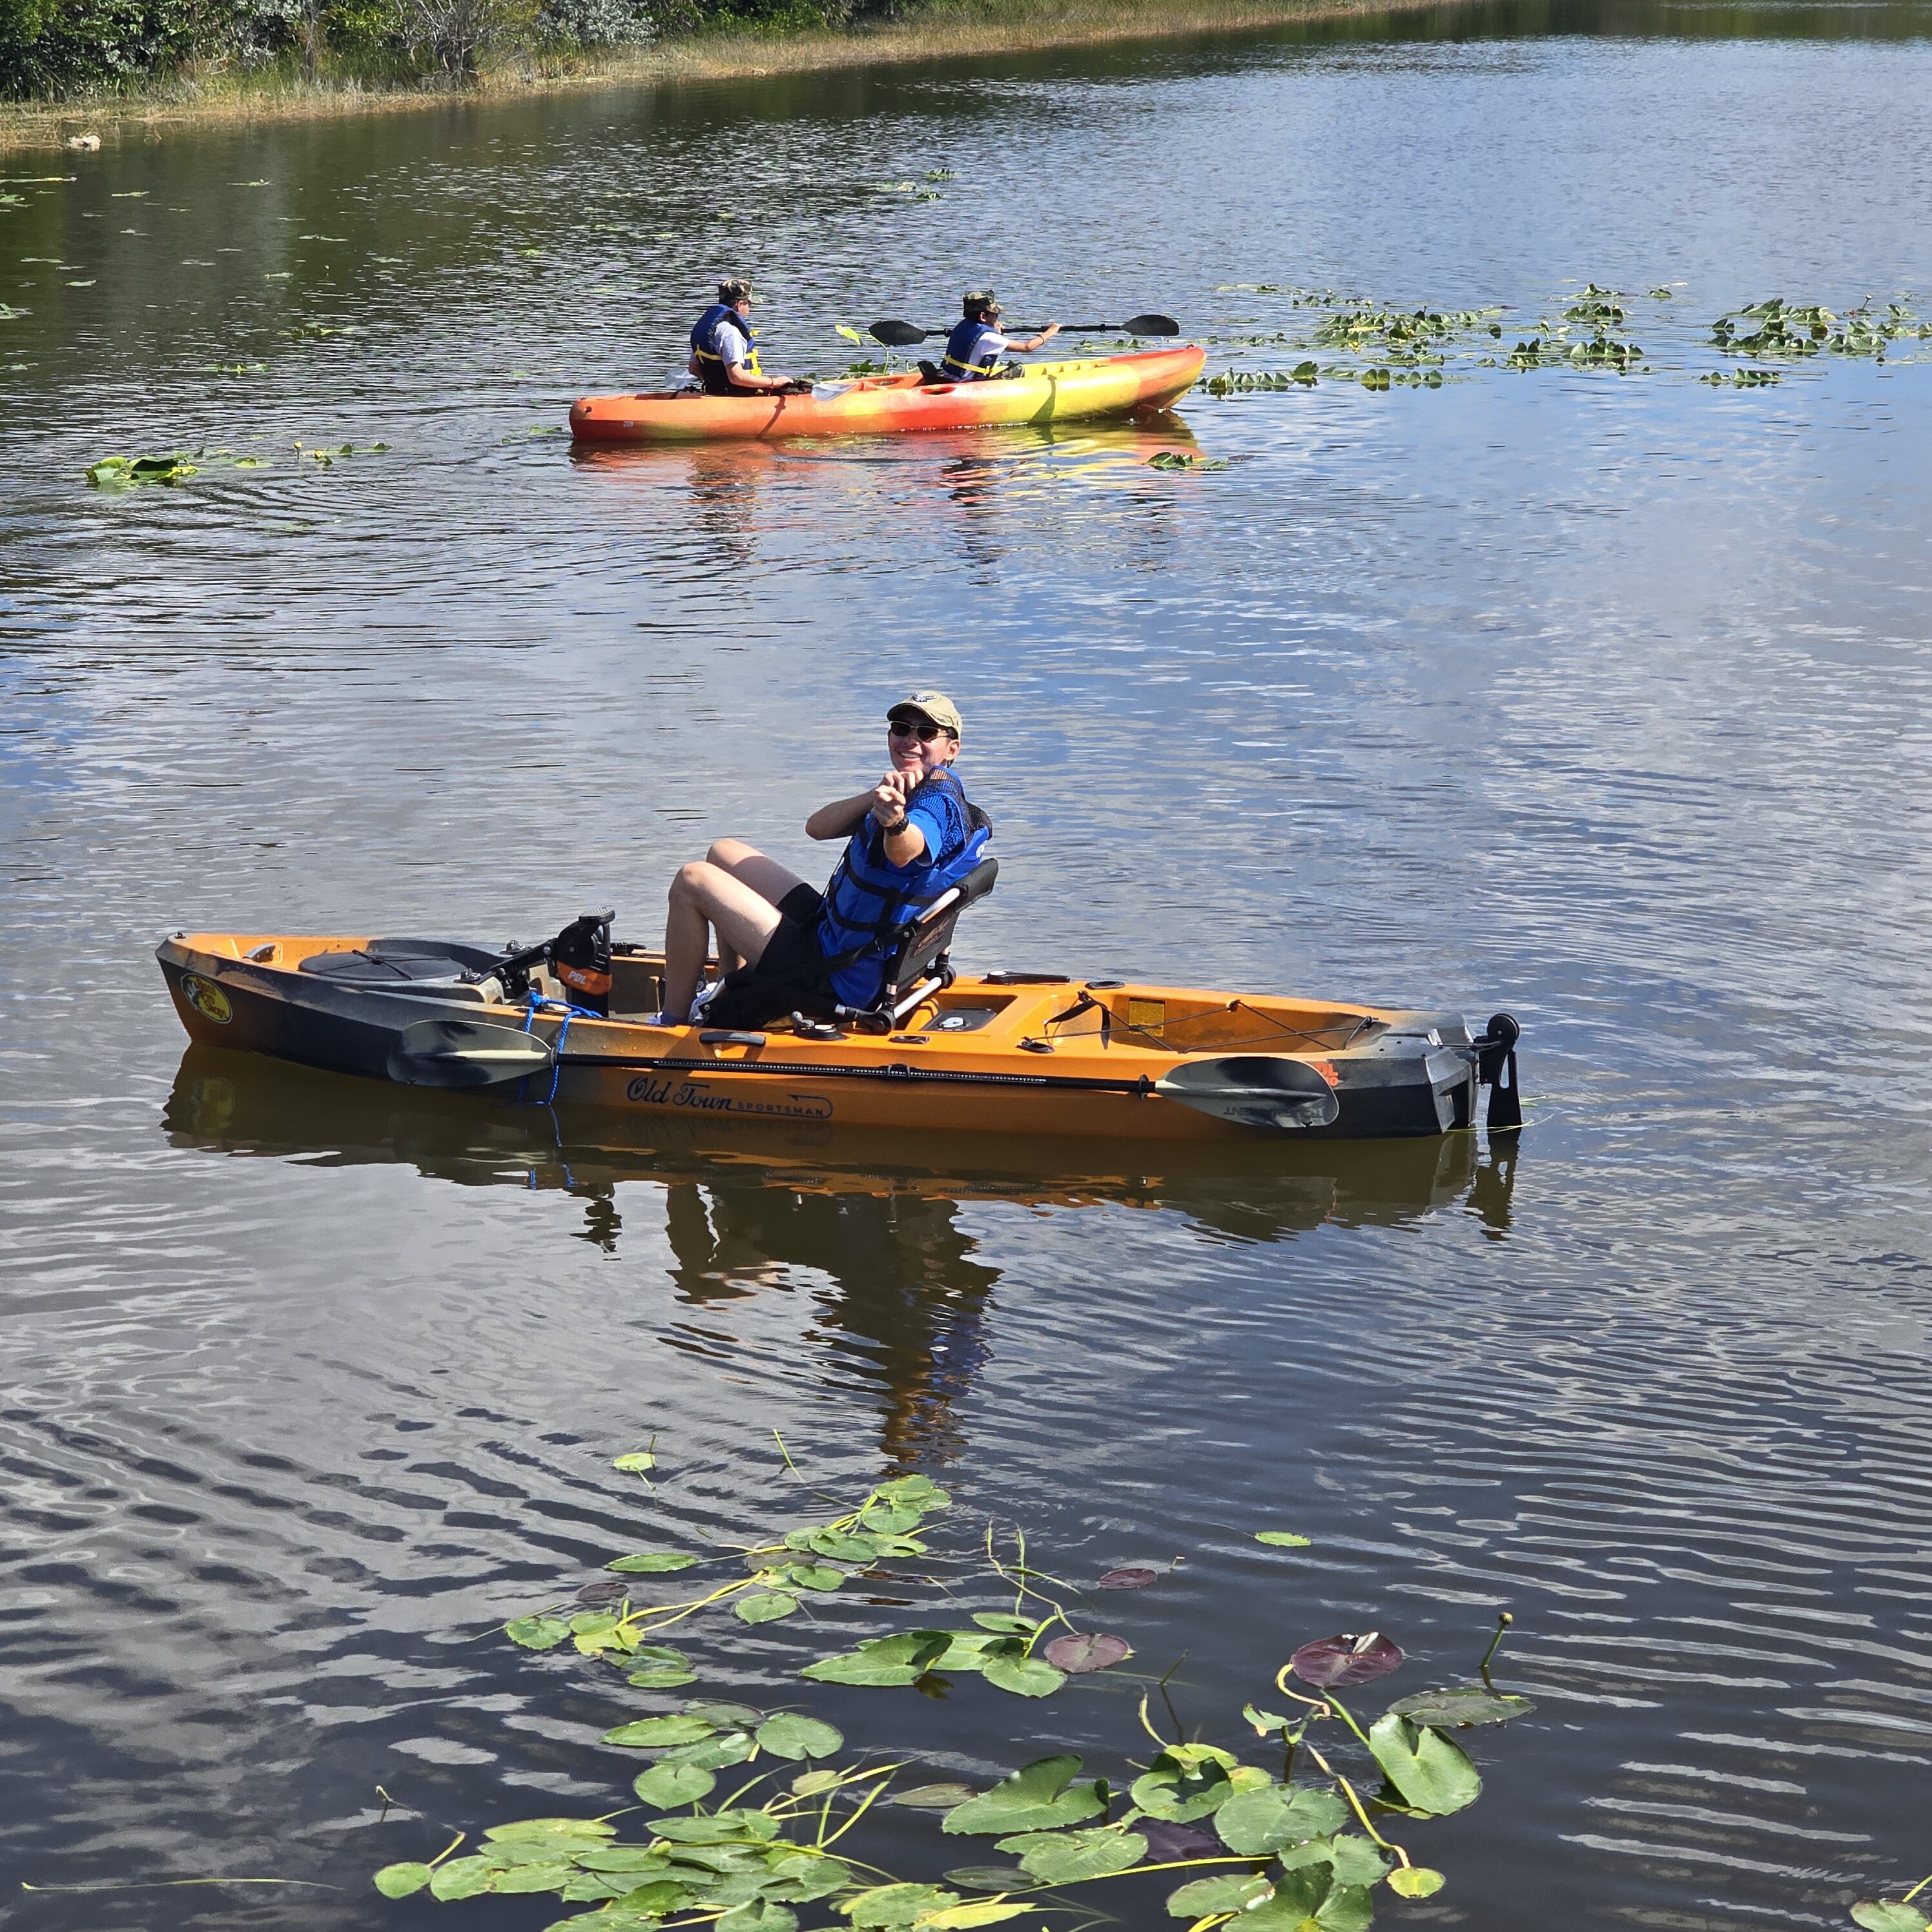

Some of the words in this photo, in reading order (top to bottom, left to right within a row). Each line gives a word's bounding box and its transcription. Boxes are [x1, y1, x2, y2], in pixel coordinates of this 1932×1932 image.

[568, 971, 586, 985] PDL
[627, 1076, 672, 1104] Old
[673, 1082, 732, 1110] Town
[737, 1102, 824, 1116] SPORTSMAN
